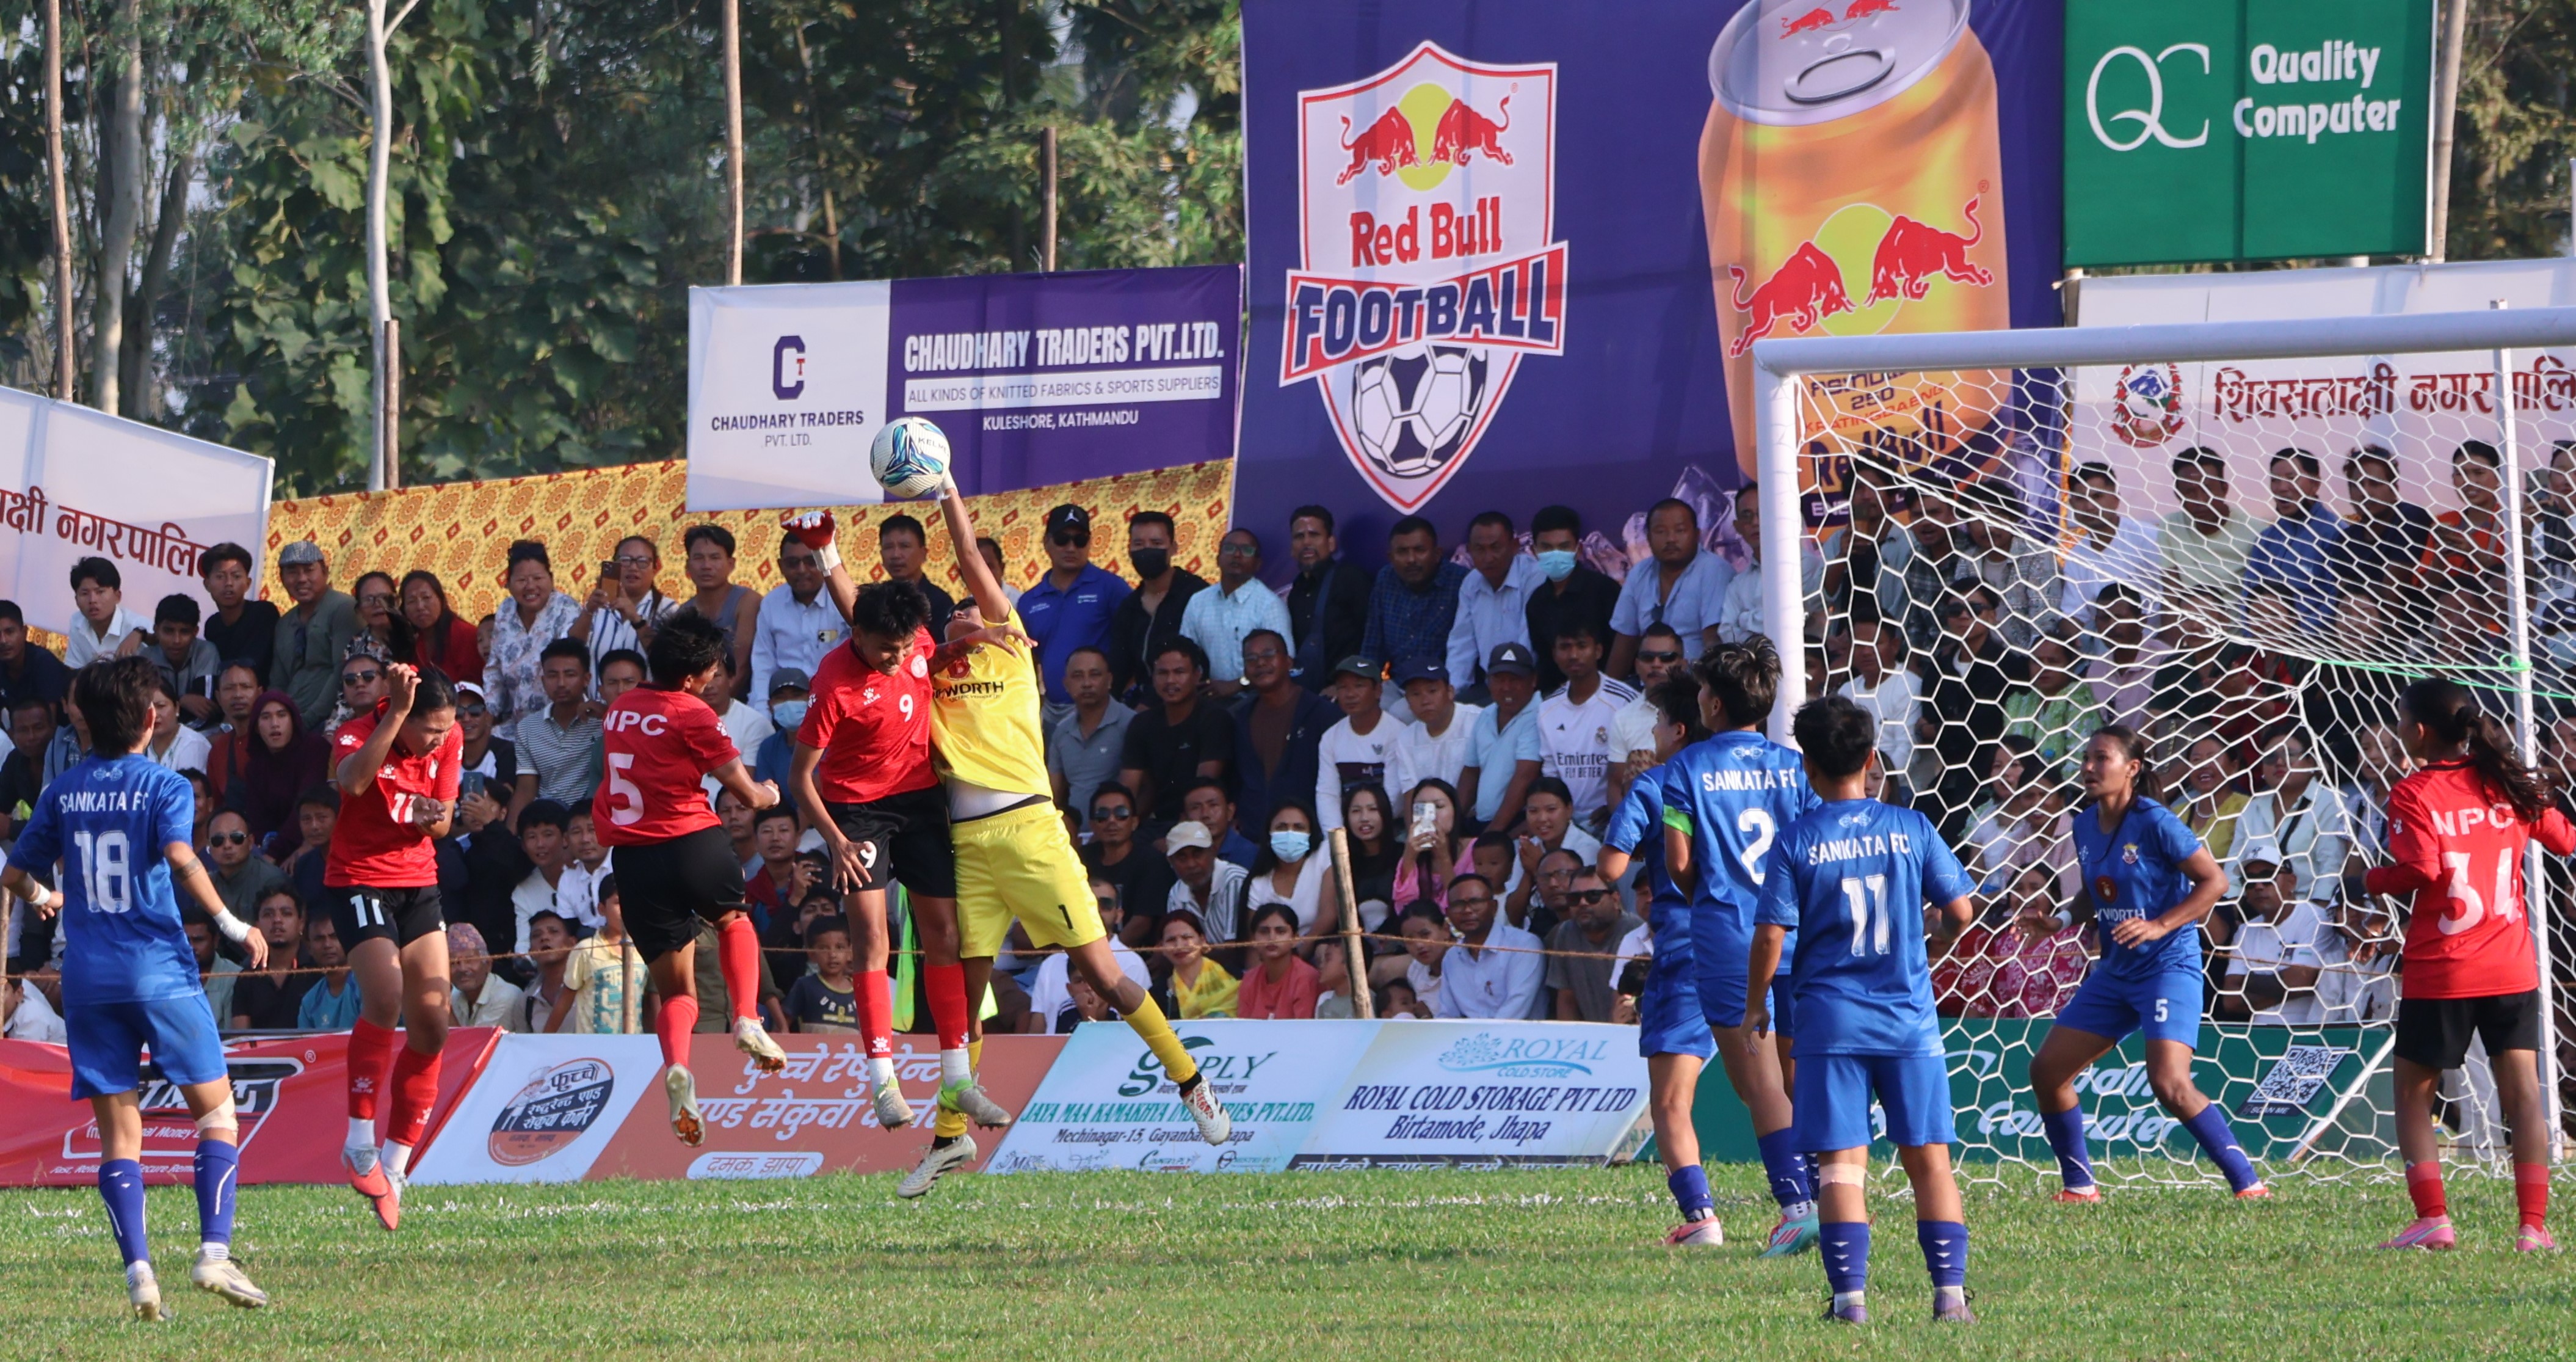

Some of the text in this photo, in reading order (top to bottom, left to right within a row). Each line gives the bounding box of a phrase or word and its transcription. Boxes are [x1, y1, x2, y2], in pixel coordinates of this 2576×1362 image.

[2250, 39, 2381, 89] Quality
[2233, 93, 2401, 145] Computer
[1349, 196, 1502, 268] Red Bull
[1290, 257, 1558, 371] FOOTBALL
[904, 321, 1224, 372] CHAUDHARY TRADERS PVT.LTD.
[909, 376, 1219, 402] ALL KINDS OF KNITTED FABRICS & SPORTS SUPPLIERS
[1851, 388, 1895, 410] 250
[712, 410, 864, 431] CHAUDHARY TRADERS
[983, 410, 1139, 431] KULESHORE, KATHMANDU
[765, 433, 812, 447] PVT. LTD.
[899, 693, 914, 723] 9
[602, 710, 669, 737] NPC
[1556, 752, 1609, 766] Emirates
[608, 752, 644, 826] 5
[1702, 768, 1797, 792] SANKATA FC
[61, 791, 149, 814] SANKATA FC
[2431, 803, 2516, 836] NPC
[860, 840, 877, 869] 9
[1738, 808, 1775, 884] 2
[1809, 833, 1910, 865] SANKATA FC
[74, 831, 132, 914] 18
[2437, 847, 2523, 936] 34
[350, 894, 385, 928] 11
[1059, 904, 1073, 930] 1
[1841, 873, 1891, 957] 11
[2154, 998, 2168, 1023] 5
[1501, 1038, 1608, 1060] ROYAL
[1497, 1068, 1572, 1078] COLD STORE
[1344, 1085, 1637, 1112] ROYAL COLD STORAGE PVT LTD
[1020, 1103, 1060, 1122] JAYA
[1058, 1103, 1093, 1122] MAA
[1090, 1103, 1170, 1122] KAMAKHYA
[155, 1126, 194, 1140] Money
[1051, 1128, 1144, 1146] Mechinagar-15,
[1384, 1114, 1551, 1147] Birtamode, Jhapa
